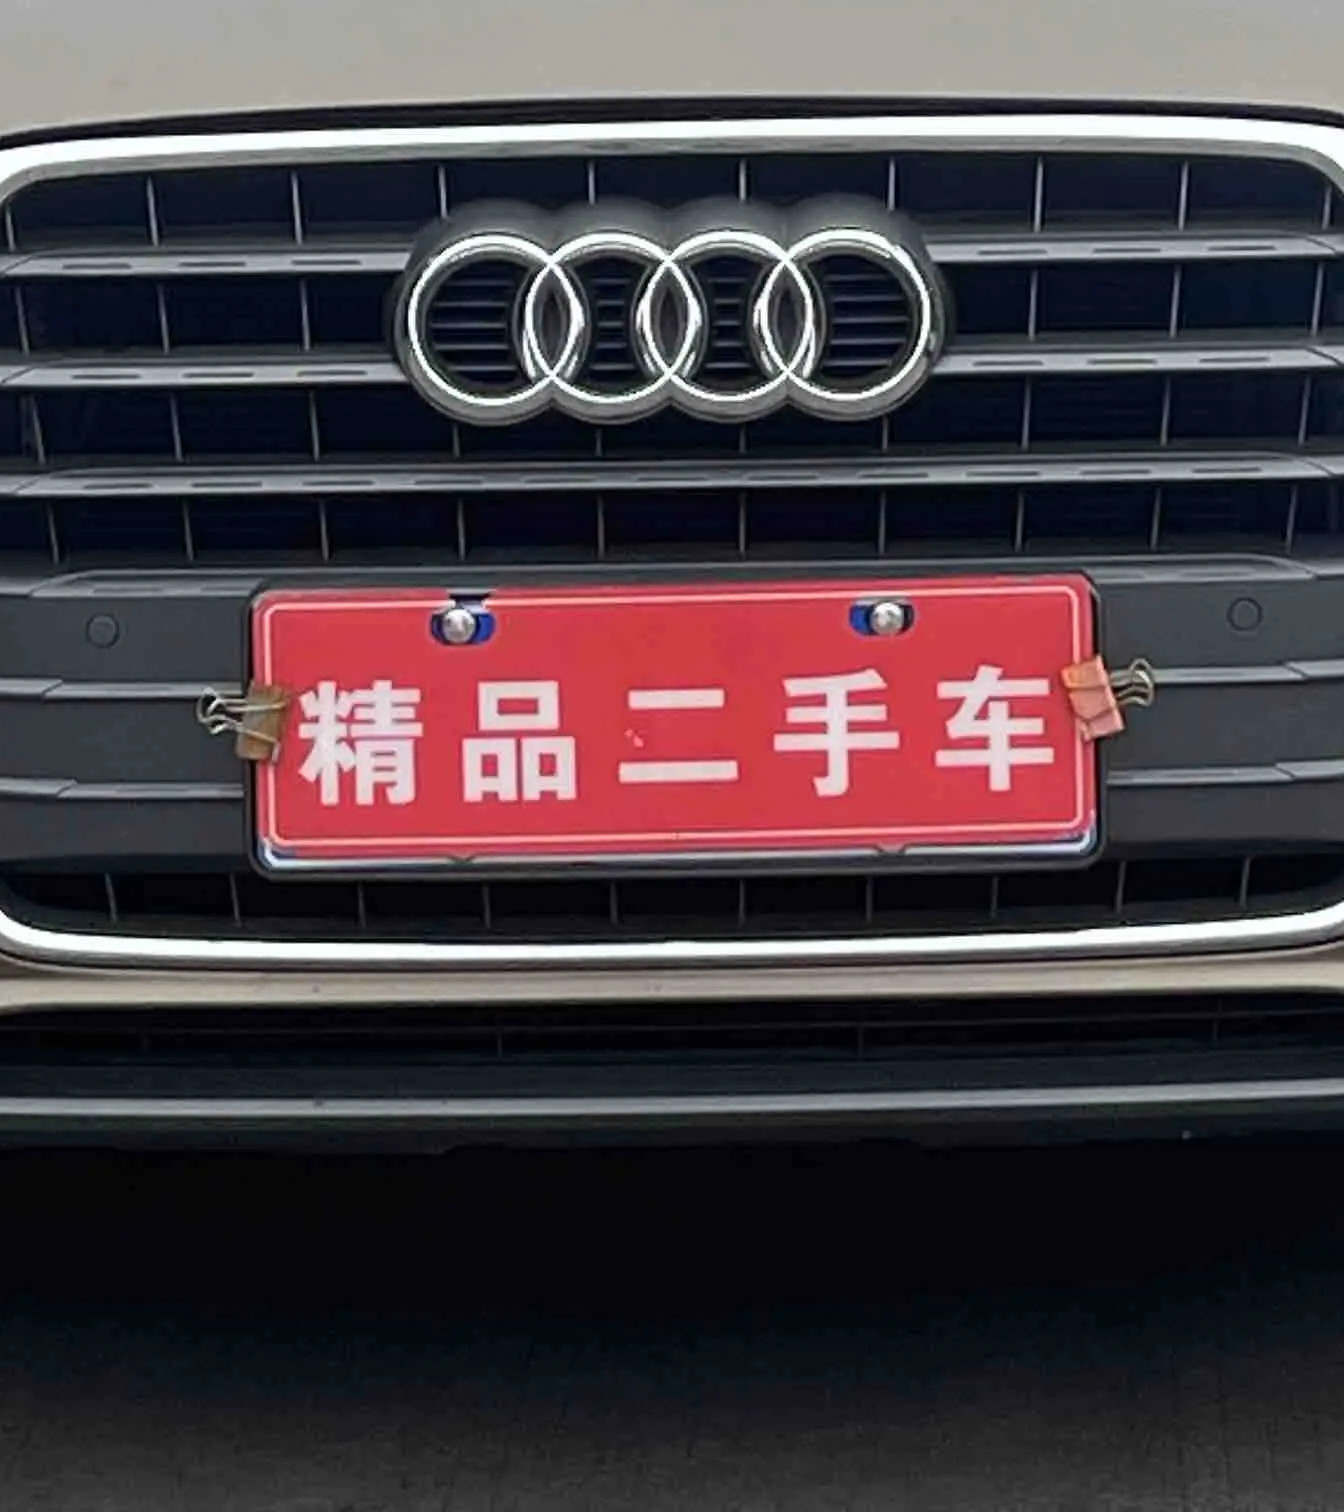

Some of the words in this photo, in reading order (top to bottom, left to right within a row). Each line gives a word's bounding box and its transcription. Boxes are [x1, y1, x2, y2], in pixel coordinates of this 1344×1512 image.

[298, 665, 1055, 807] 精品二手车
